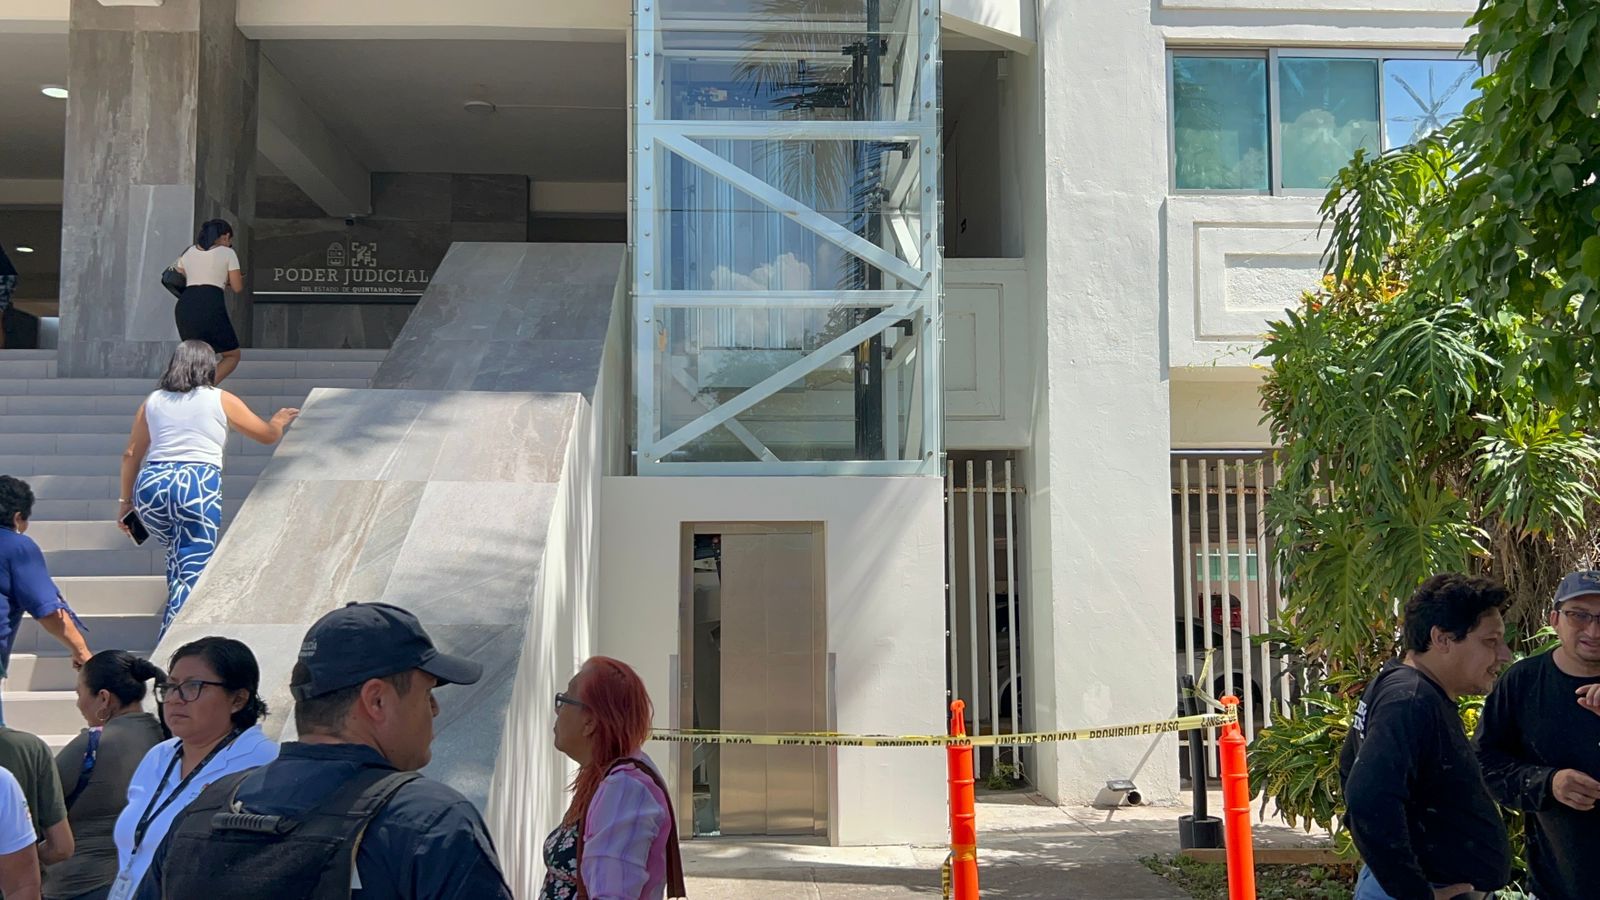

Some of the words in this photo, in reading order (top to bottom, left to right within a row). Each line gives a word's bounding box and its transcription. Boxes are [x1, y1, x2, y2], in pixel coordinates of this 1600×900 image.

[273, 268, 339, 282] PODER
[343, 269, 429, 286] JUDICIAL
[352, 286, 388, 294] QUINTANA
[1155, 720, 1180, 734] PASO
